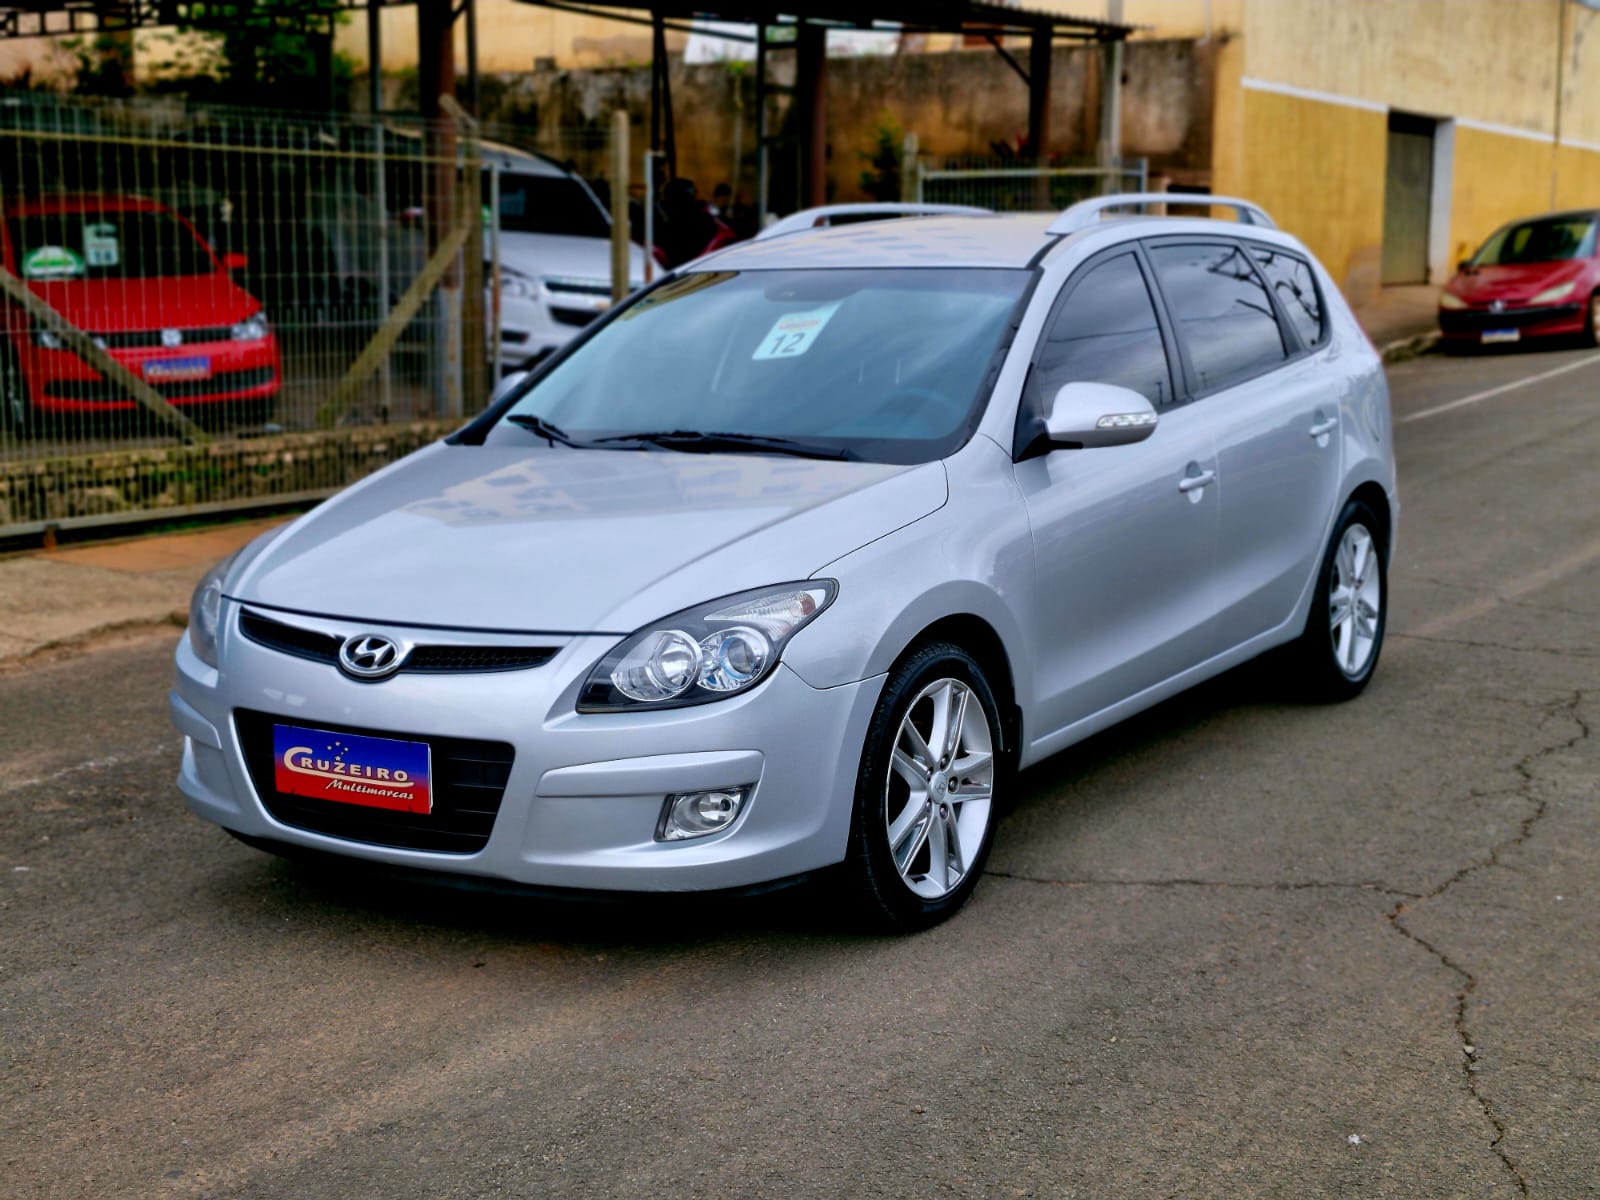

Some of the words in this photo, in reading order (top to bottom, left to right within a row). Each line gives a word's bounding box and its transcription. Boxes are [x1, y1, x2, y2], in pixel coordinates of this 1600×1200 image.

[770, 332, 805, 354] 12
[283, 746, 412, 786] CRUZEIRO
[325, 779, 414, 800] Multimarcas
